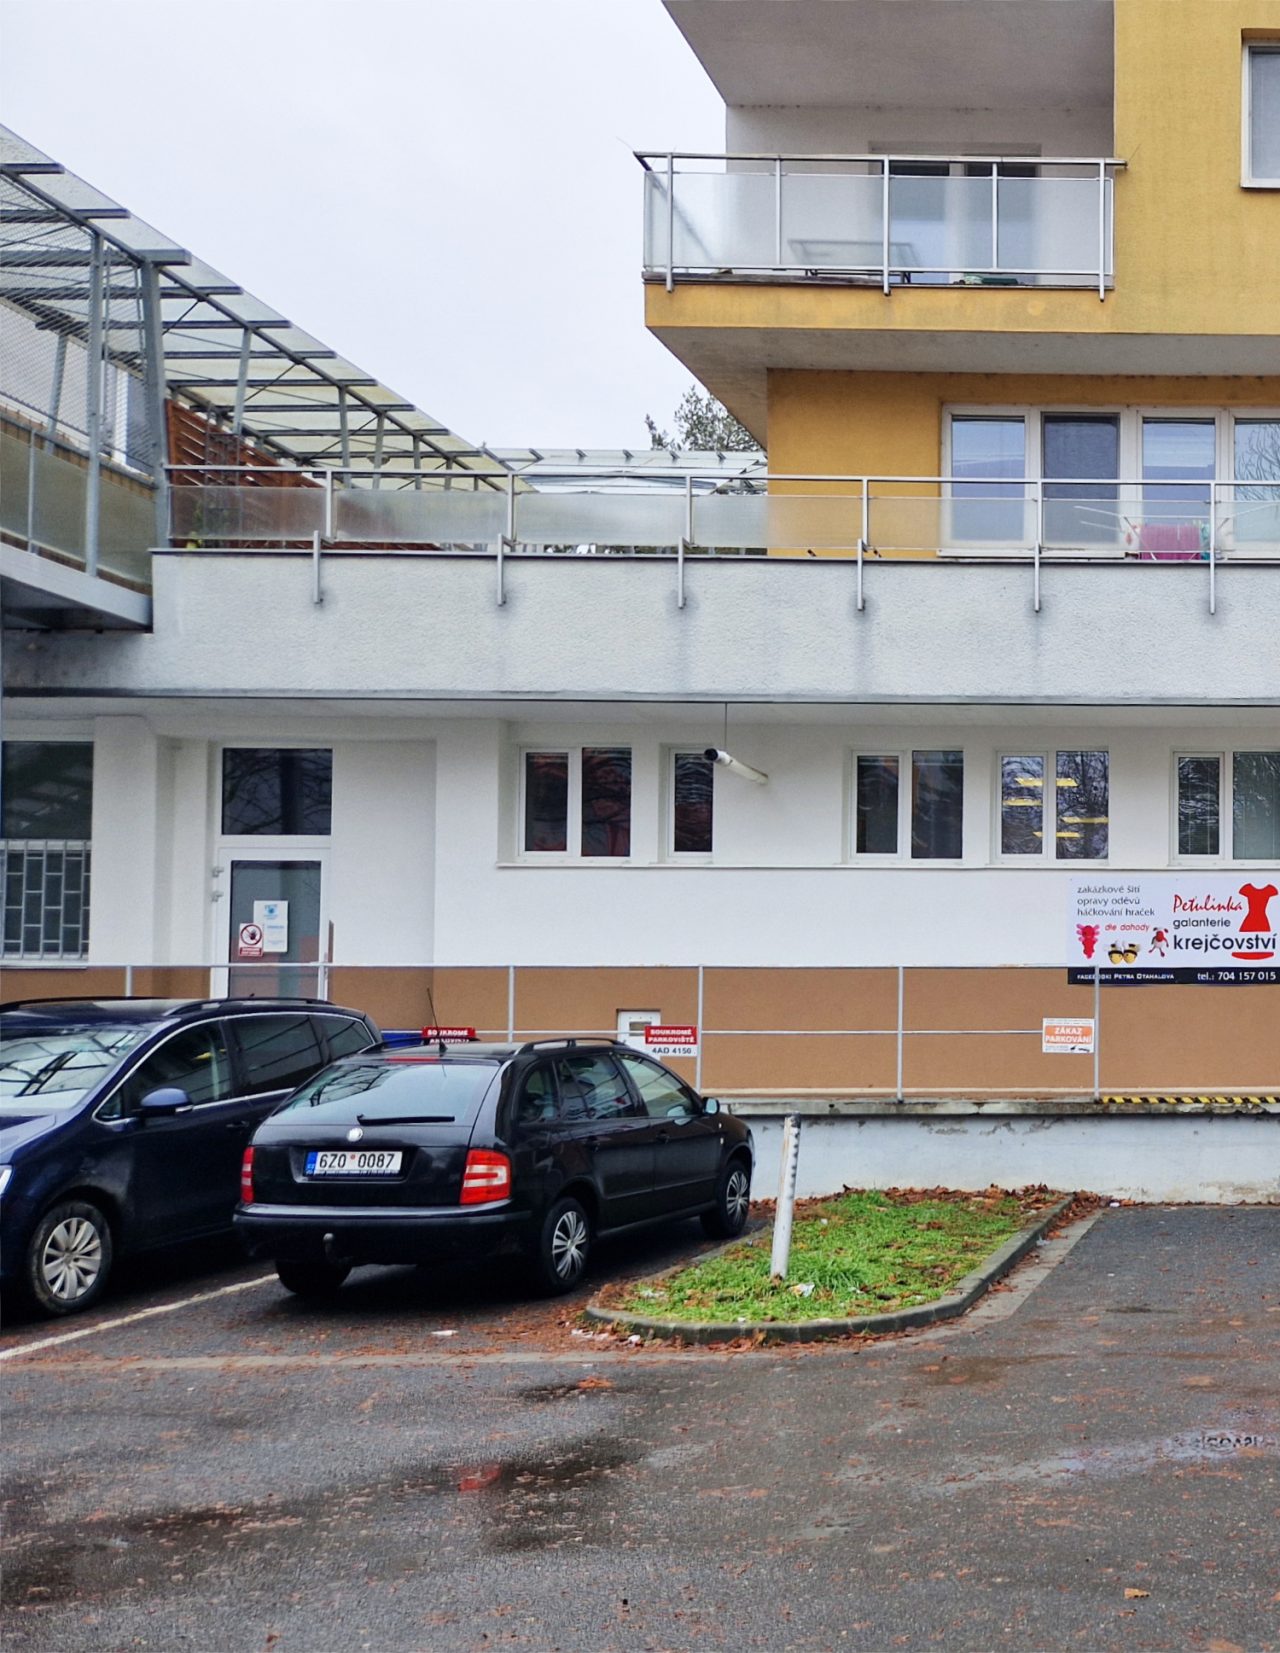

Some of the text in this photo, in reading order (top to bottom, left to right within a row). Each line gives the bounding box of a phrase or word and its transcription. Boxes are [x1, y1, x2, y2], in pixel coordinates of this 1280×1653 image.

[1077, 885, 1140, 894] zakázkové šití
[1077, 896, 1140, 907] opravy oděvů
[1077, 907, 1155, 916] háčkování hraček
[1105, 923, 1117, 931] dle
[1172, 918, 1231, 930] galanterie
[1173, 933, 1277, 953] krejčovství
[1218, 971, 1235, 981] 704
[1239, 971, 1256, 981] 157
[1258, 971, 1276, 981] 015
[319, 1153, 395, 1168] 6Z0 0087
